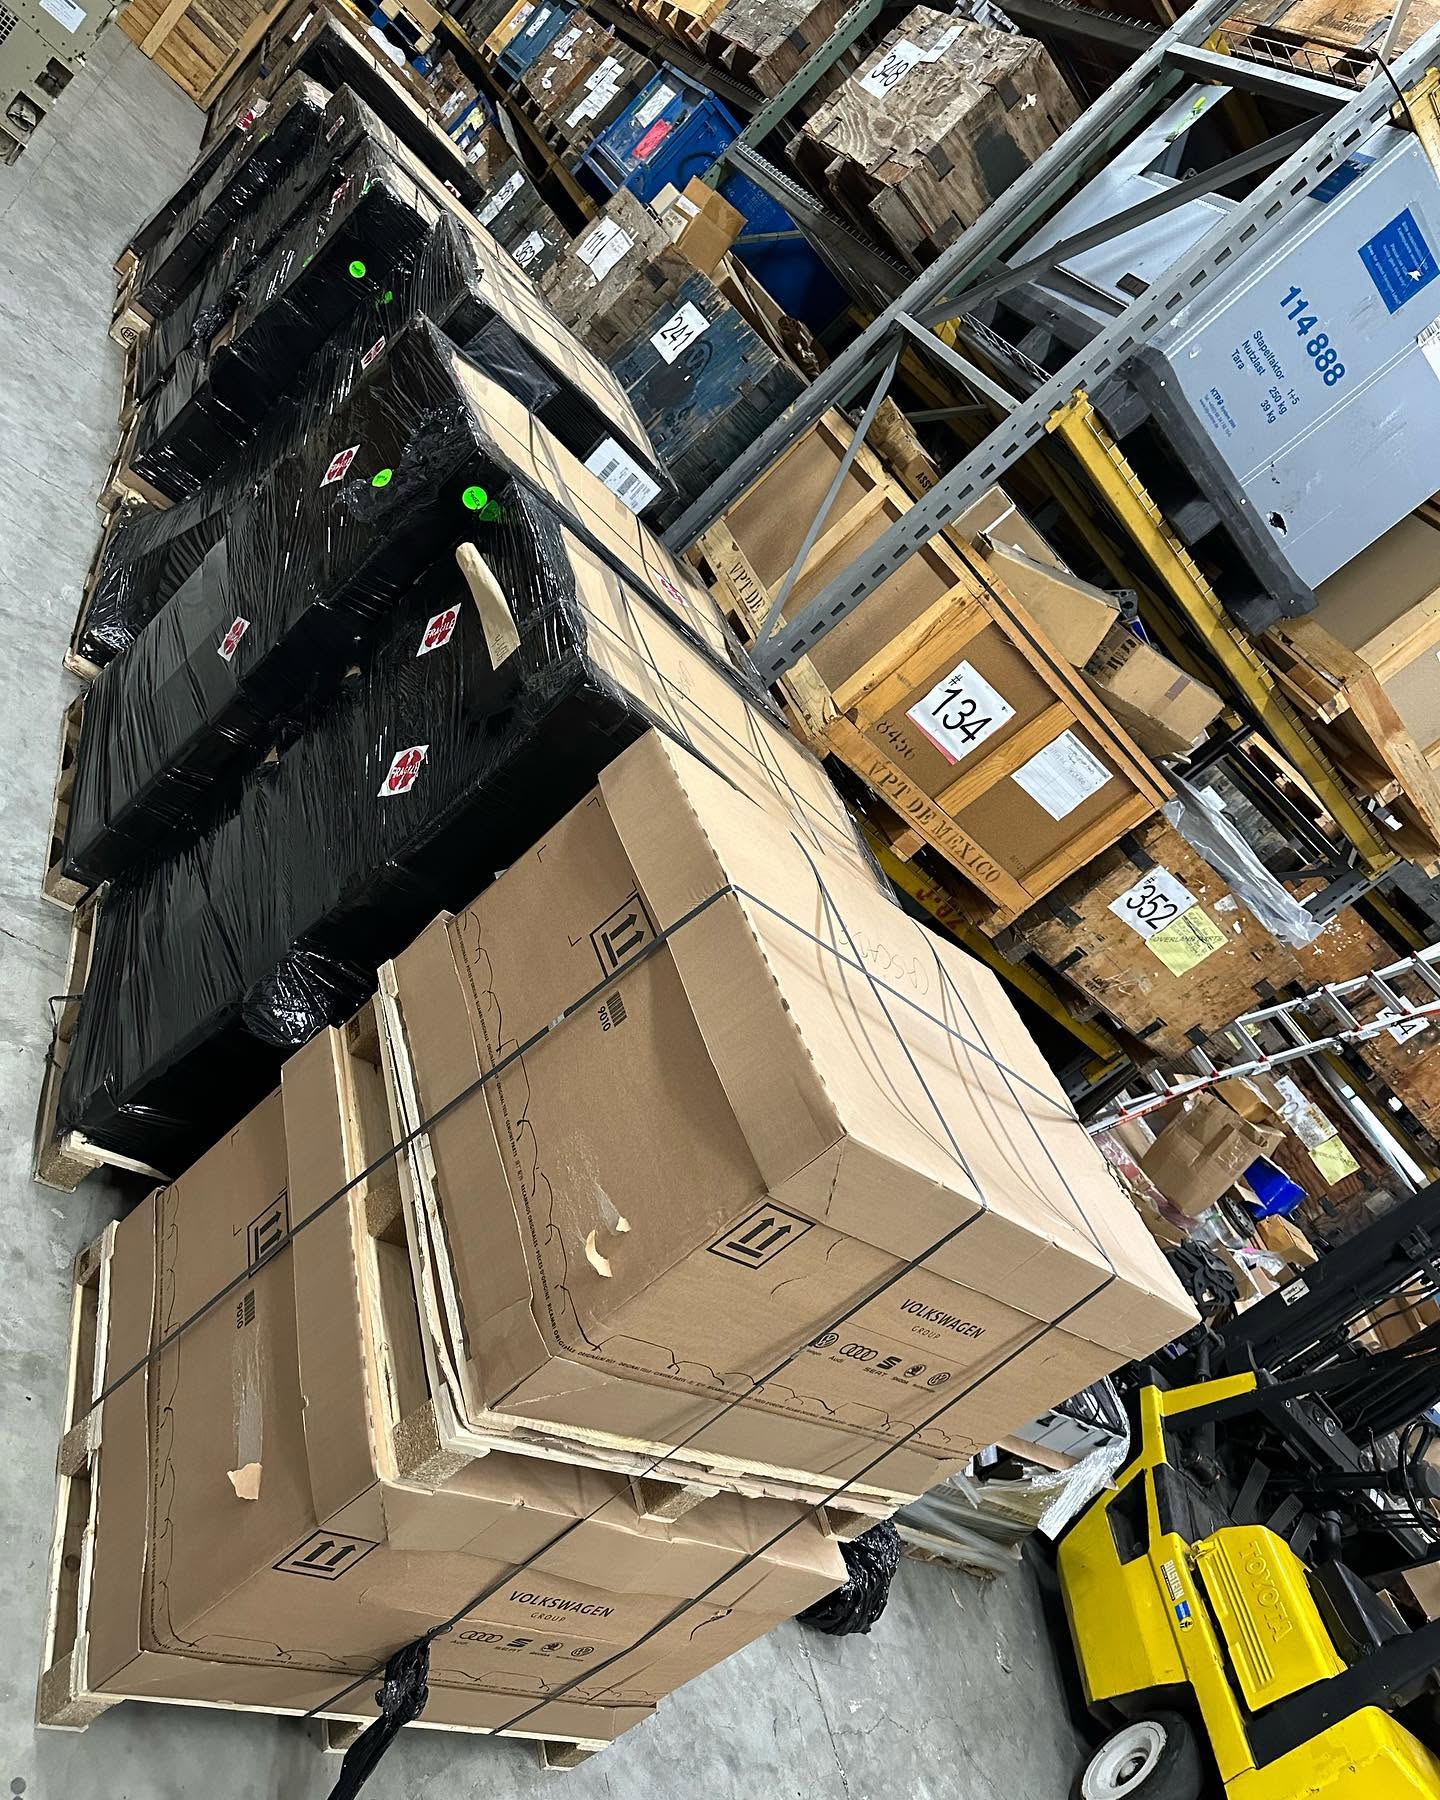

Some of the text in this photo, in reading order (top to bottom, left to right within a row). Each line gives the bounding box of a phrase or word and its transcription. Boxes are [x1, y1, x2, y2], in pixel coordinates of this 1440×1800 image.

[872, 55, 909, 86] 348
[584, 231, 606, 254] 111
[660, 317, 694, 351] 241
[1280, 286, 1345, 386] 114 888
[1242, 340, 1288, 415] Nutzlast 250 kg
[1253, 330, 1300, 405] Stapelfaktor 1+5
[1231, 349, 1277, 424] Tara 39 kg
[730, 562, 765, 614] VPT DE
[427, 620, 455, 638] FRAGILE
[949, 674, 963, 686] #
[931, 688, 993, 744] 134
[392, 762, 419, 778] FRAGILE
[868, 760, 911, 799] VPT
[906, 797, 936, 825] DE
[932, 820, 1000, 883] MEXICO
[1126, 885, 1178, 930] 352
[598, 1006, 611, 1031] 9010
[900, 1299, 986, 1339] VOLKSWAGEN
[911, 1325, 941, 1340] GROUP
[862, 1367, 888, 1377] SEAT
[1163, 1559, 1184, 1600] BILSTEIN
[1239, 1541, 1293, 1642] TOYOTA
[509, 1591, 615, 1617] VOLKSWAGEN
[530, 1611, 567, 1622] GROUP
